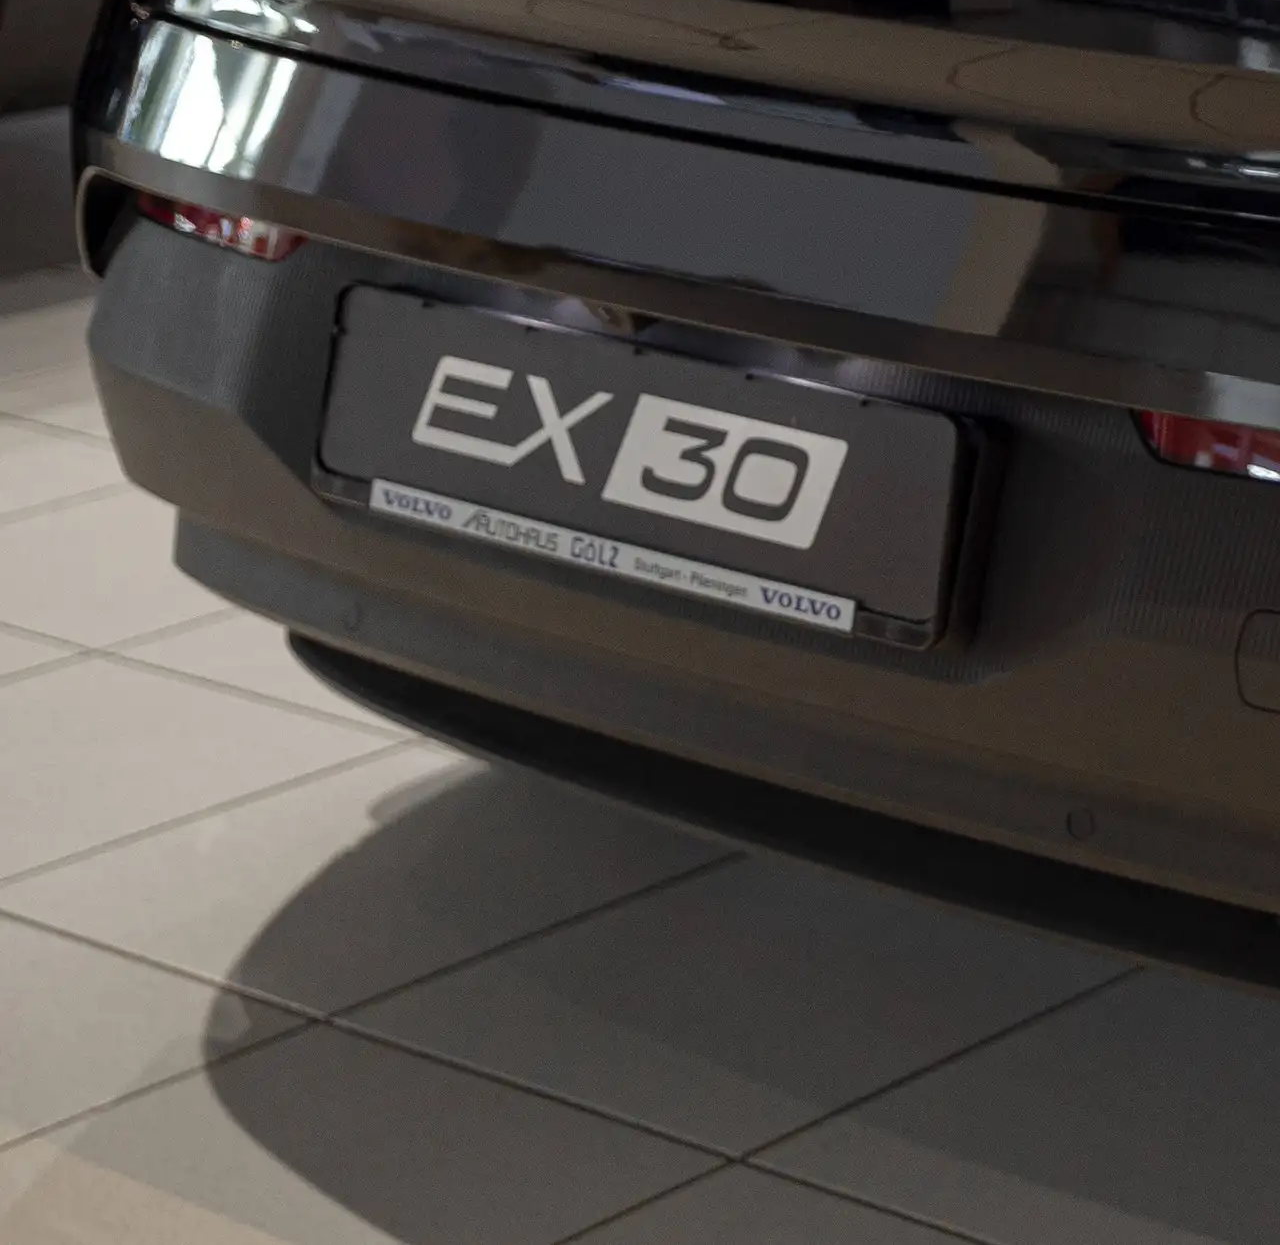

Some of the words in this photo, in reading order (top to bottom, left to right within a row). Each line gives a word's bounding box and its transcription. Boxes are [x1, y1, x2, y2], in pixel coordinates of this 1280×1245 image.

[382, 488, 453, 520] VOLVO
[462, 508, 560, 552] AUTOHAUS
[760, 586, 841, 621] VOLVO
